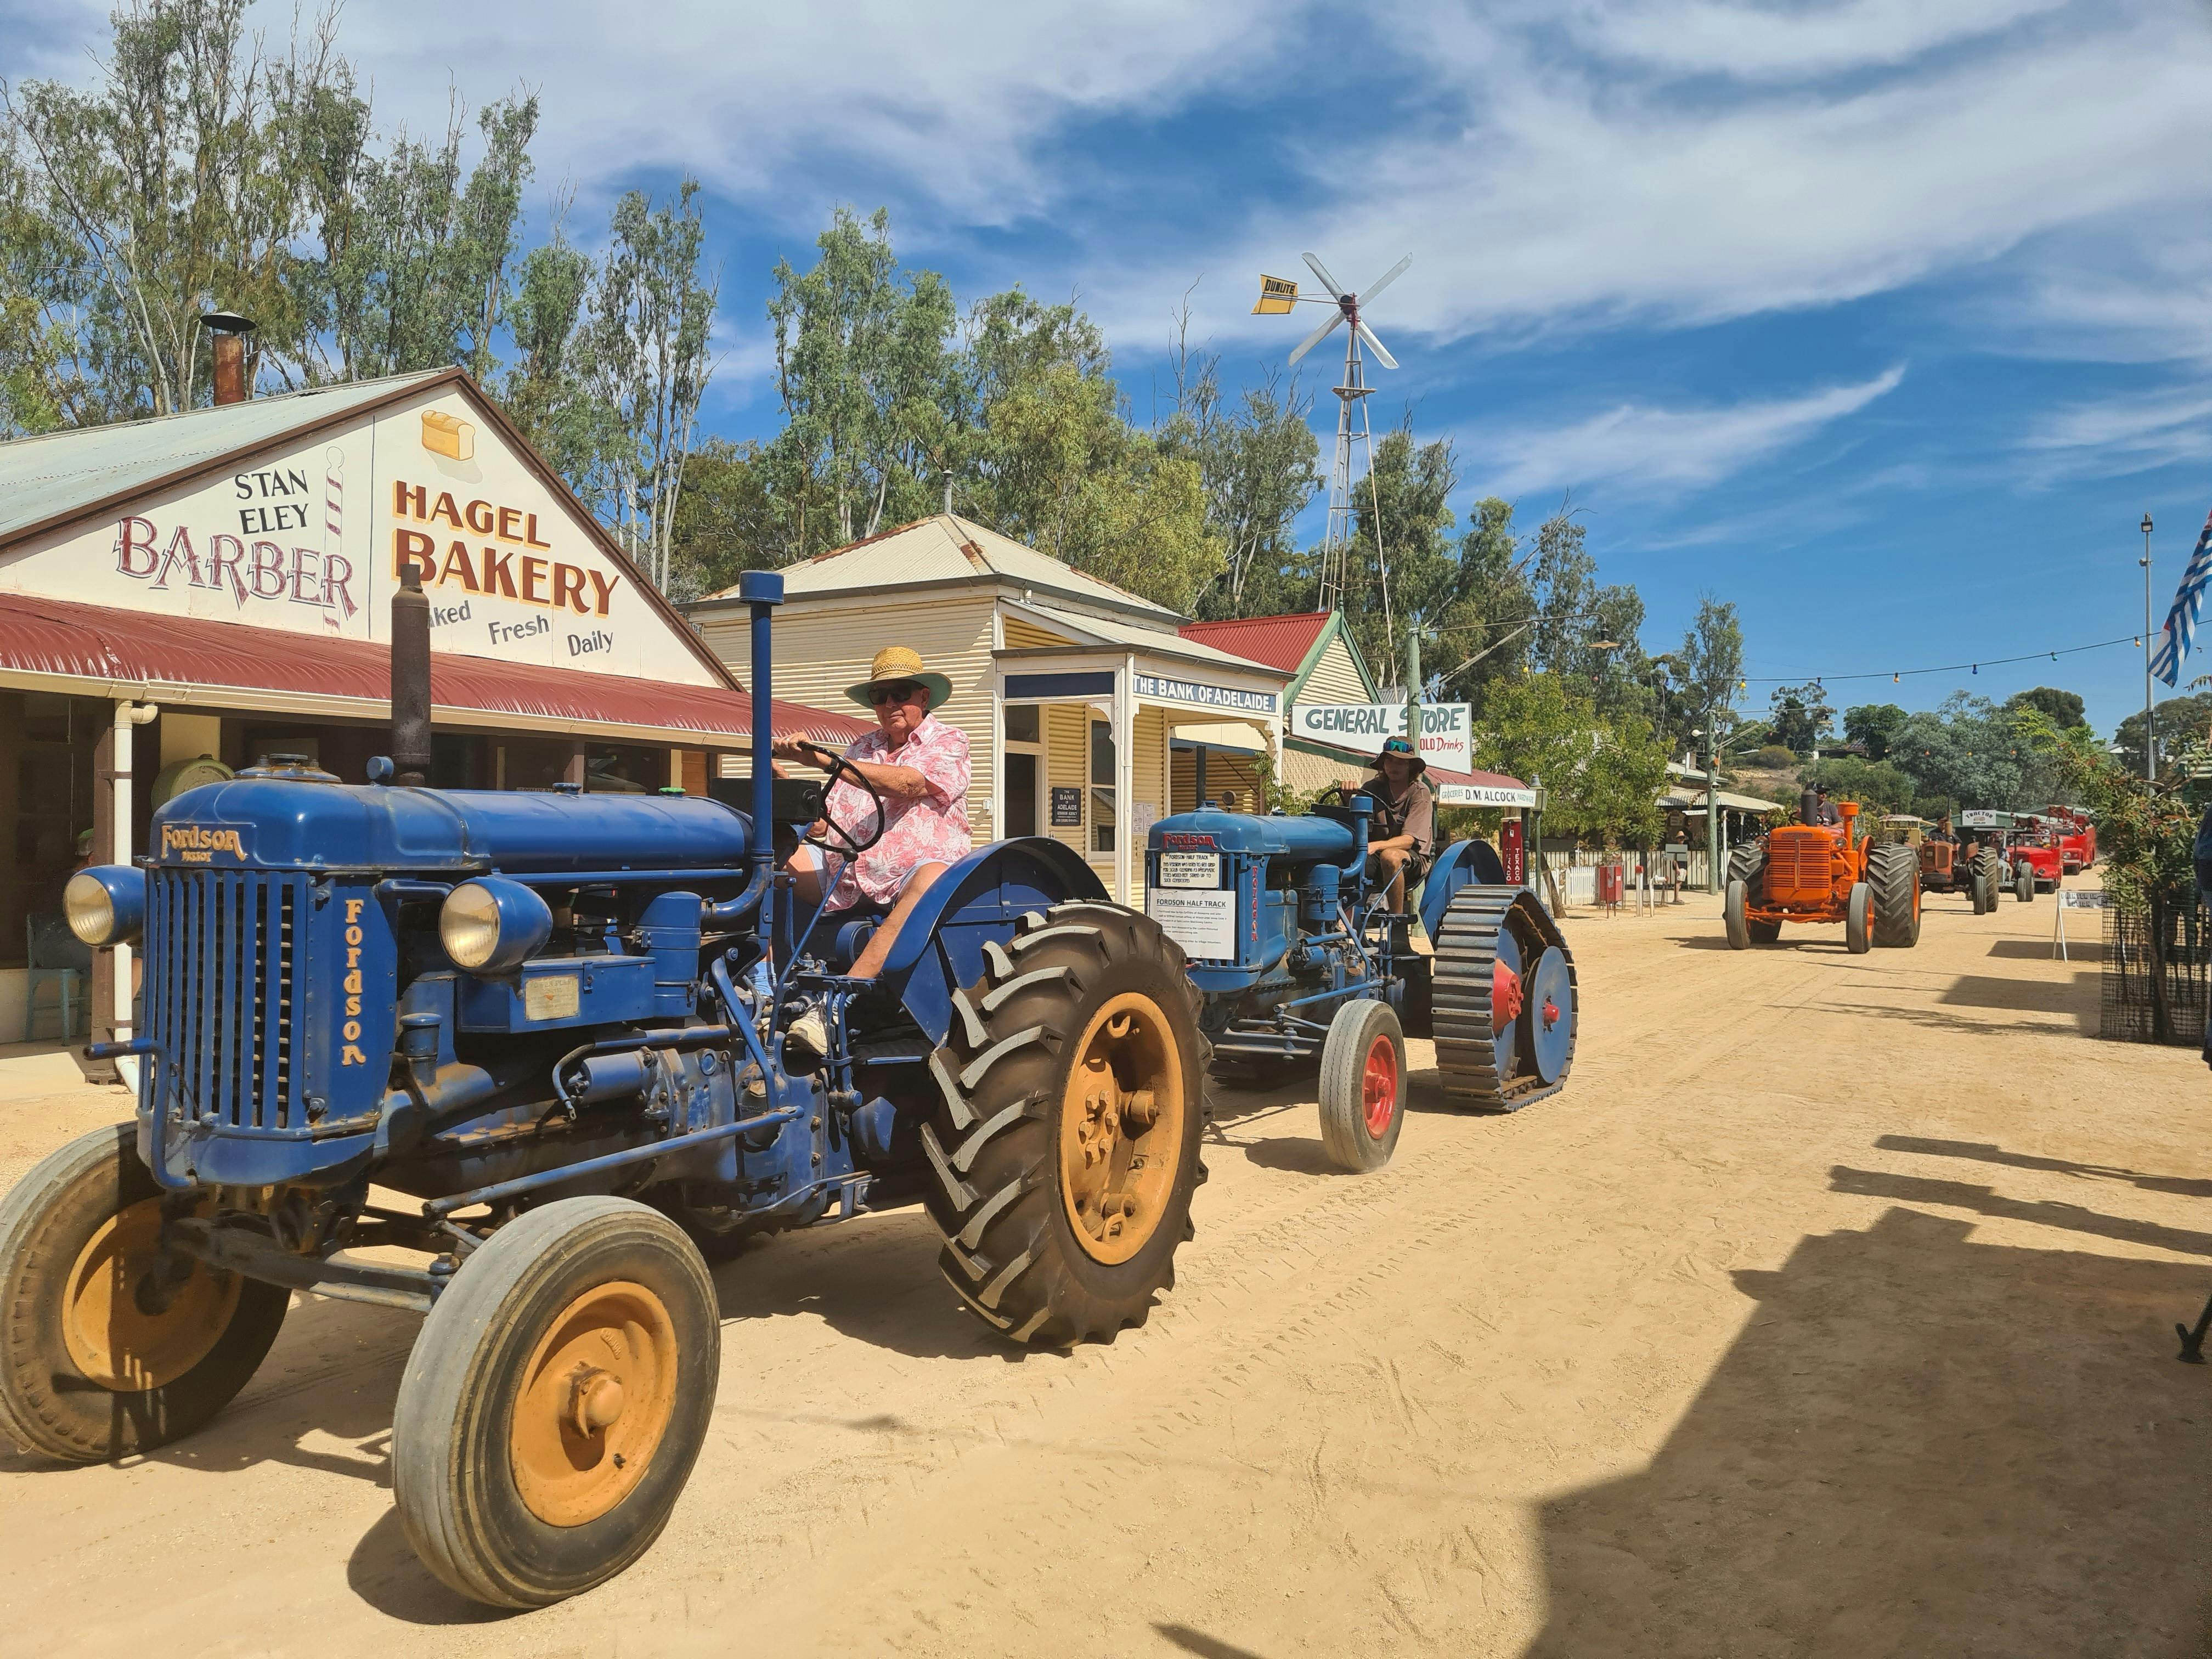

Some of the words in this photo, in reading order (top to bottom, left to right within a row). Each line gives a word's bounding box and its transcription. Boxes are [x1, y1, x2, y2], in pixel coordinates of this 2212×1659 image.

[1265, 279, 1295, 294] DUNLITE
[234, 468, 309, 500] STAN
[239, 504, 309, 535] ELEY
[392, 479, 551, 552] HAGEL
[112, 516, 359, 621] BARBER
[391, 528, 620, 619] BAKERY
[429, 600, 471, 628] ked
[488, 614, 550, 645] Fresh
[567, 630, 614, 657] Daily
[1133, 675, 1154, 695] THE
[1158, 679, 1194, 701] BANK
[1198, 686, 1212, 702] OF
[1305, 708, 1390, 734] GENERAL
[1398, 707, 1465, 734] STORE
[1419, 738, 1434, 751] OLD
[1436, 737, 1464, 753] Drinks
[1442, 789, 1463, 799] GROCERIES
[1485, 791, 1516, 802] ALCOCK
[161, 825, 248, 861] Fordson
[1163, 833, 1217, 850] Fordson
[341, 899, 366, 1066] Fordson
